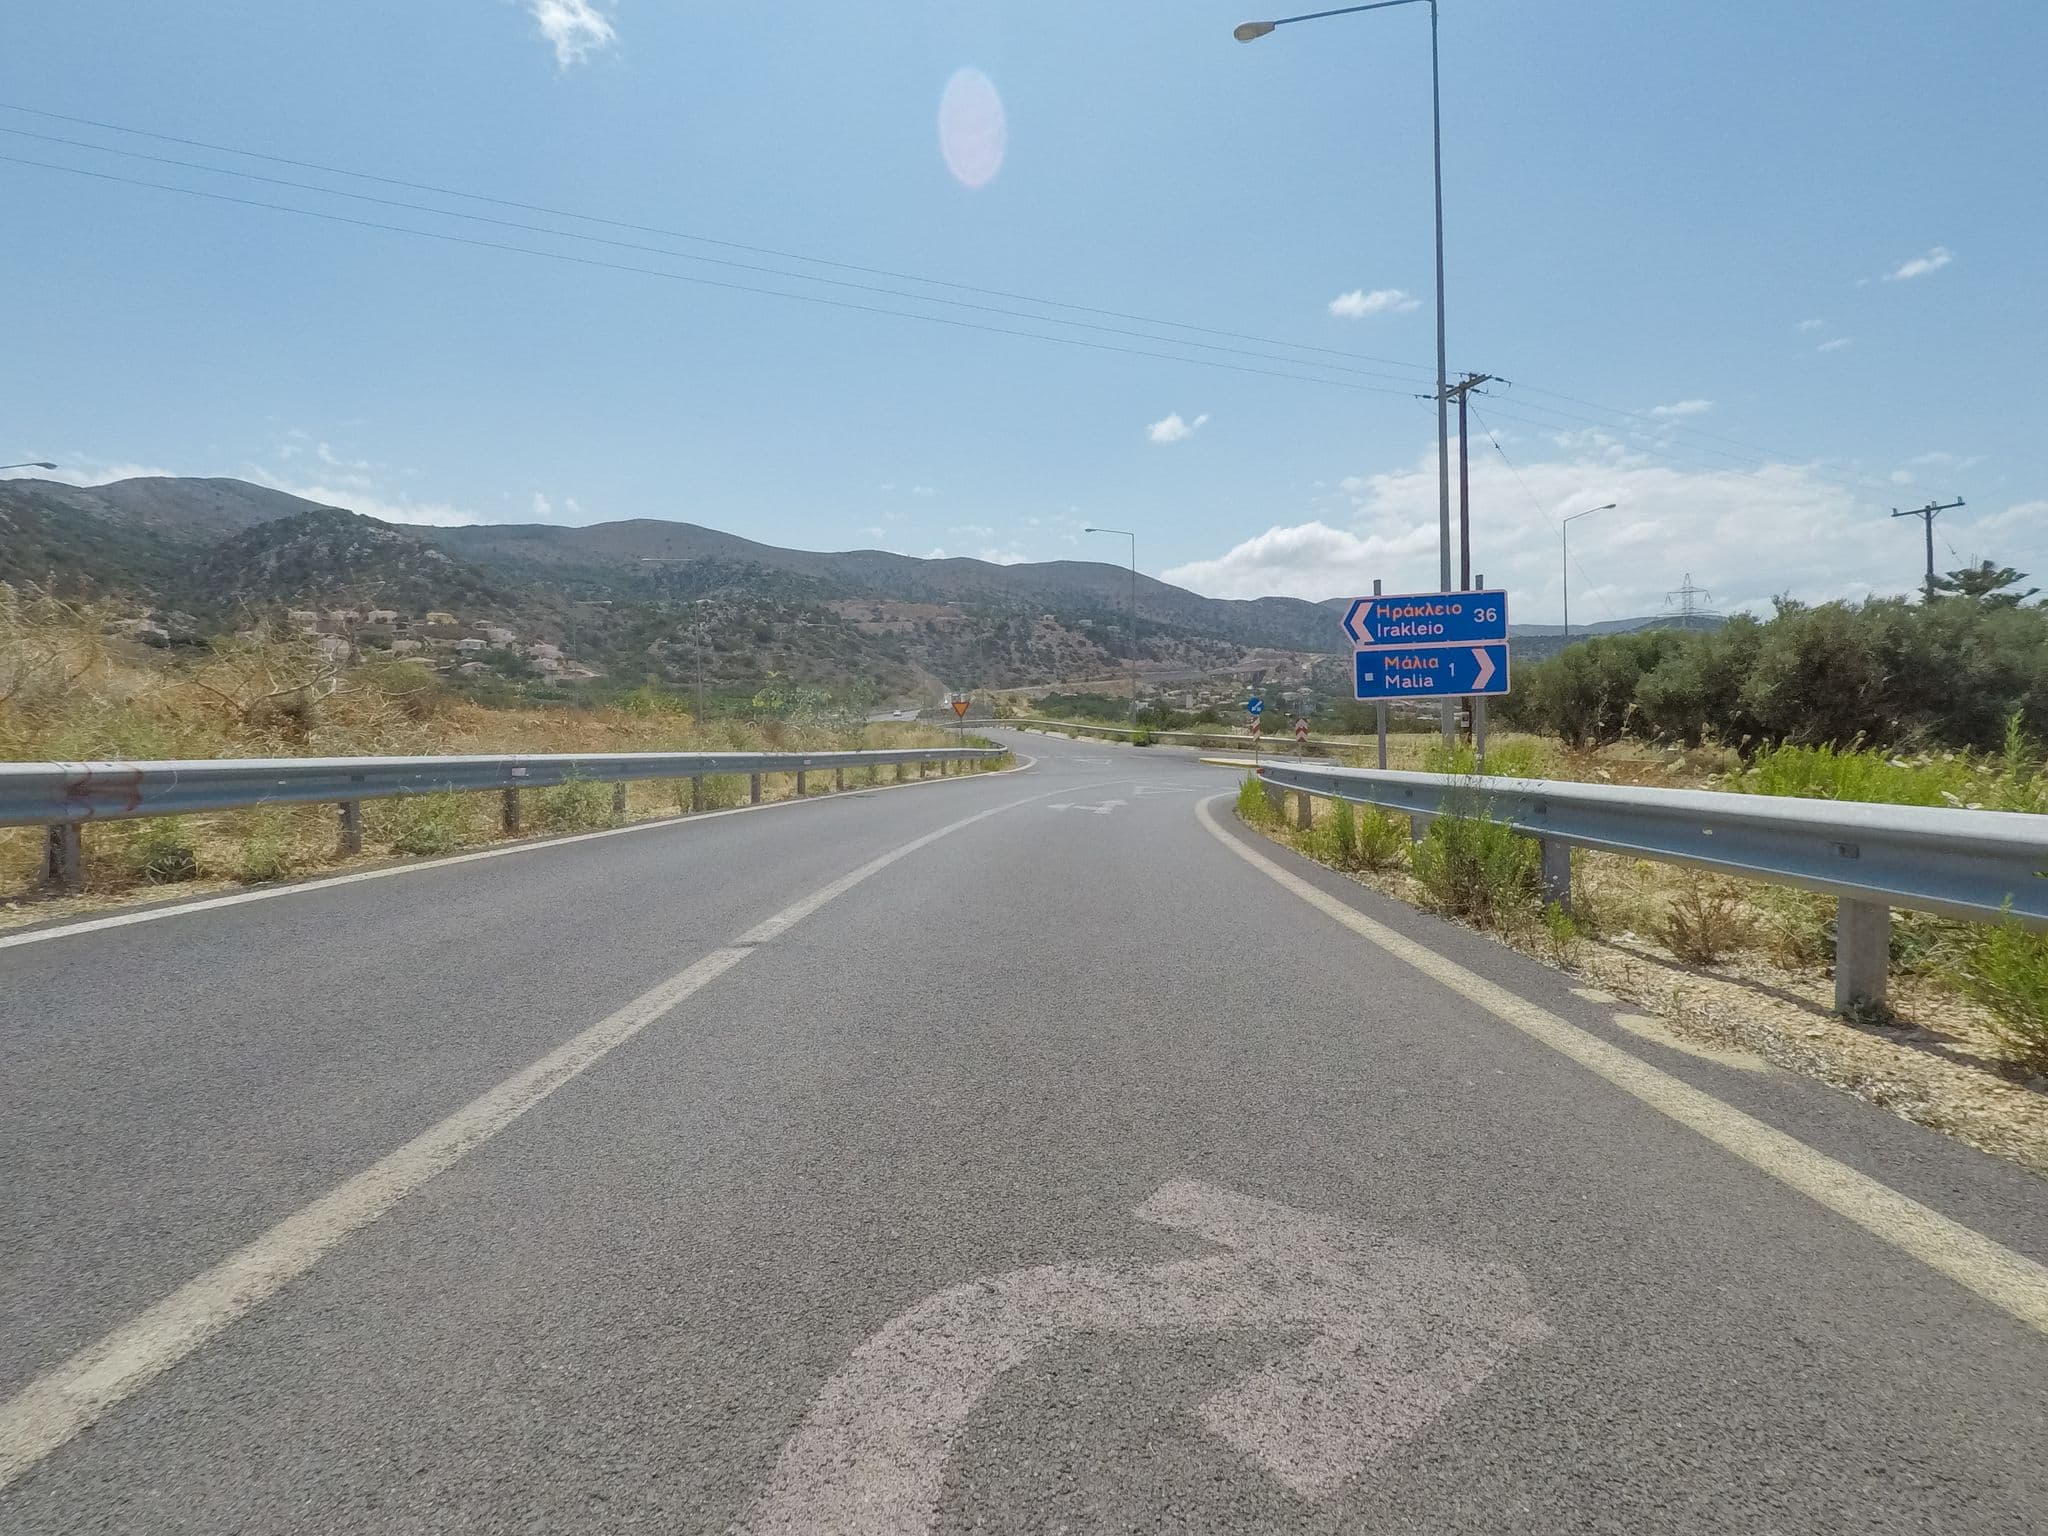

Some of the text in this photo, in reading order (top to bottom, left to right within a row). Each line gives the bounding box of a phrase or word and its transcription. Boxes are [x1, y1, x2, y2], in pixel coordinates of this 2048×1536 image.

[1376, 602, 1497, 622] Ηράκλειο 36
[1377, 622, 1444, 637] Irakleio
[1384, 655, 1455, 677] Μάλια 1
[1385, 673, 1434, 689] Malia
